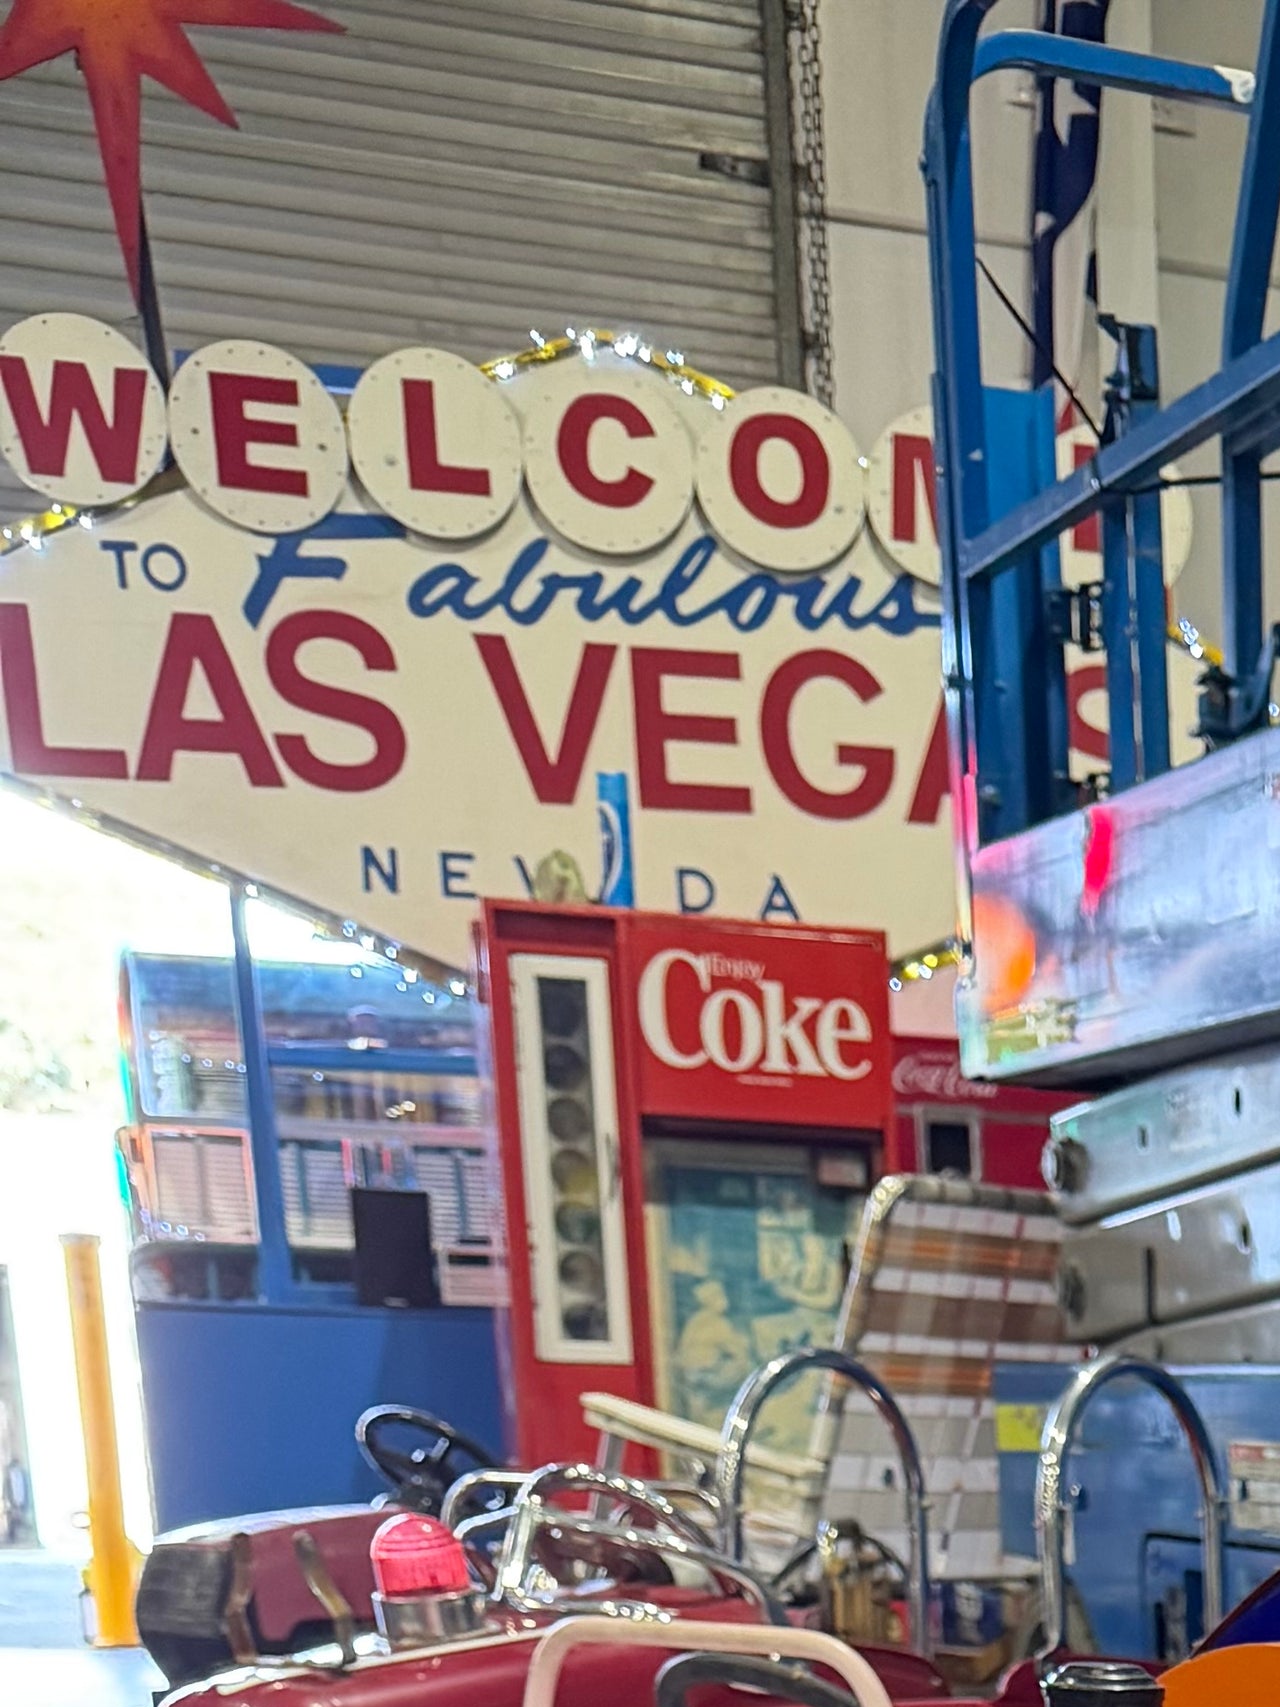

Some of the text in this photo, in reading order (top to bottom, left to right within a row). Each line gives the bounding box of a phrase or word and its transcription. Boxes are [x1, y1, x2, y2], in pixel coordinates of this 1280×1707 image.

[0, 353, 1100, 553] WELCO
[102, 512, 944, 635] TO Fabulous
[0, 602, 1110, 824] LAS VEG
[362, 845, 803, 923] NEDA
[638, 947, 873, 1081] Coke
